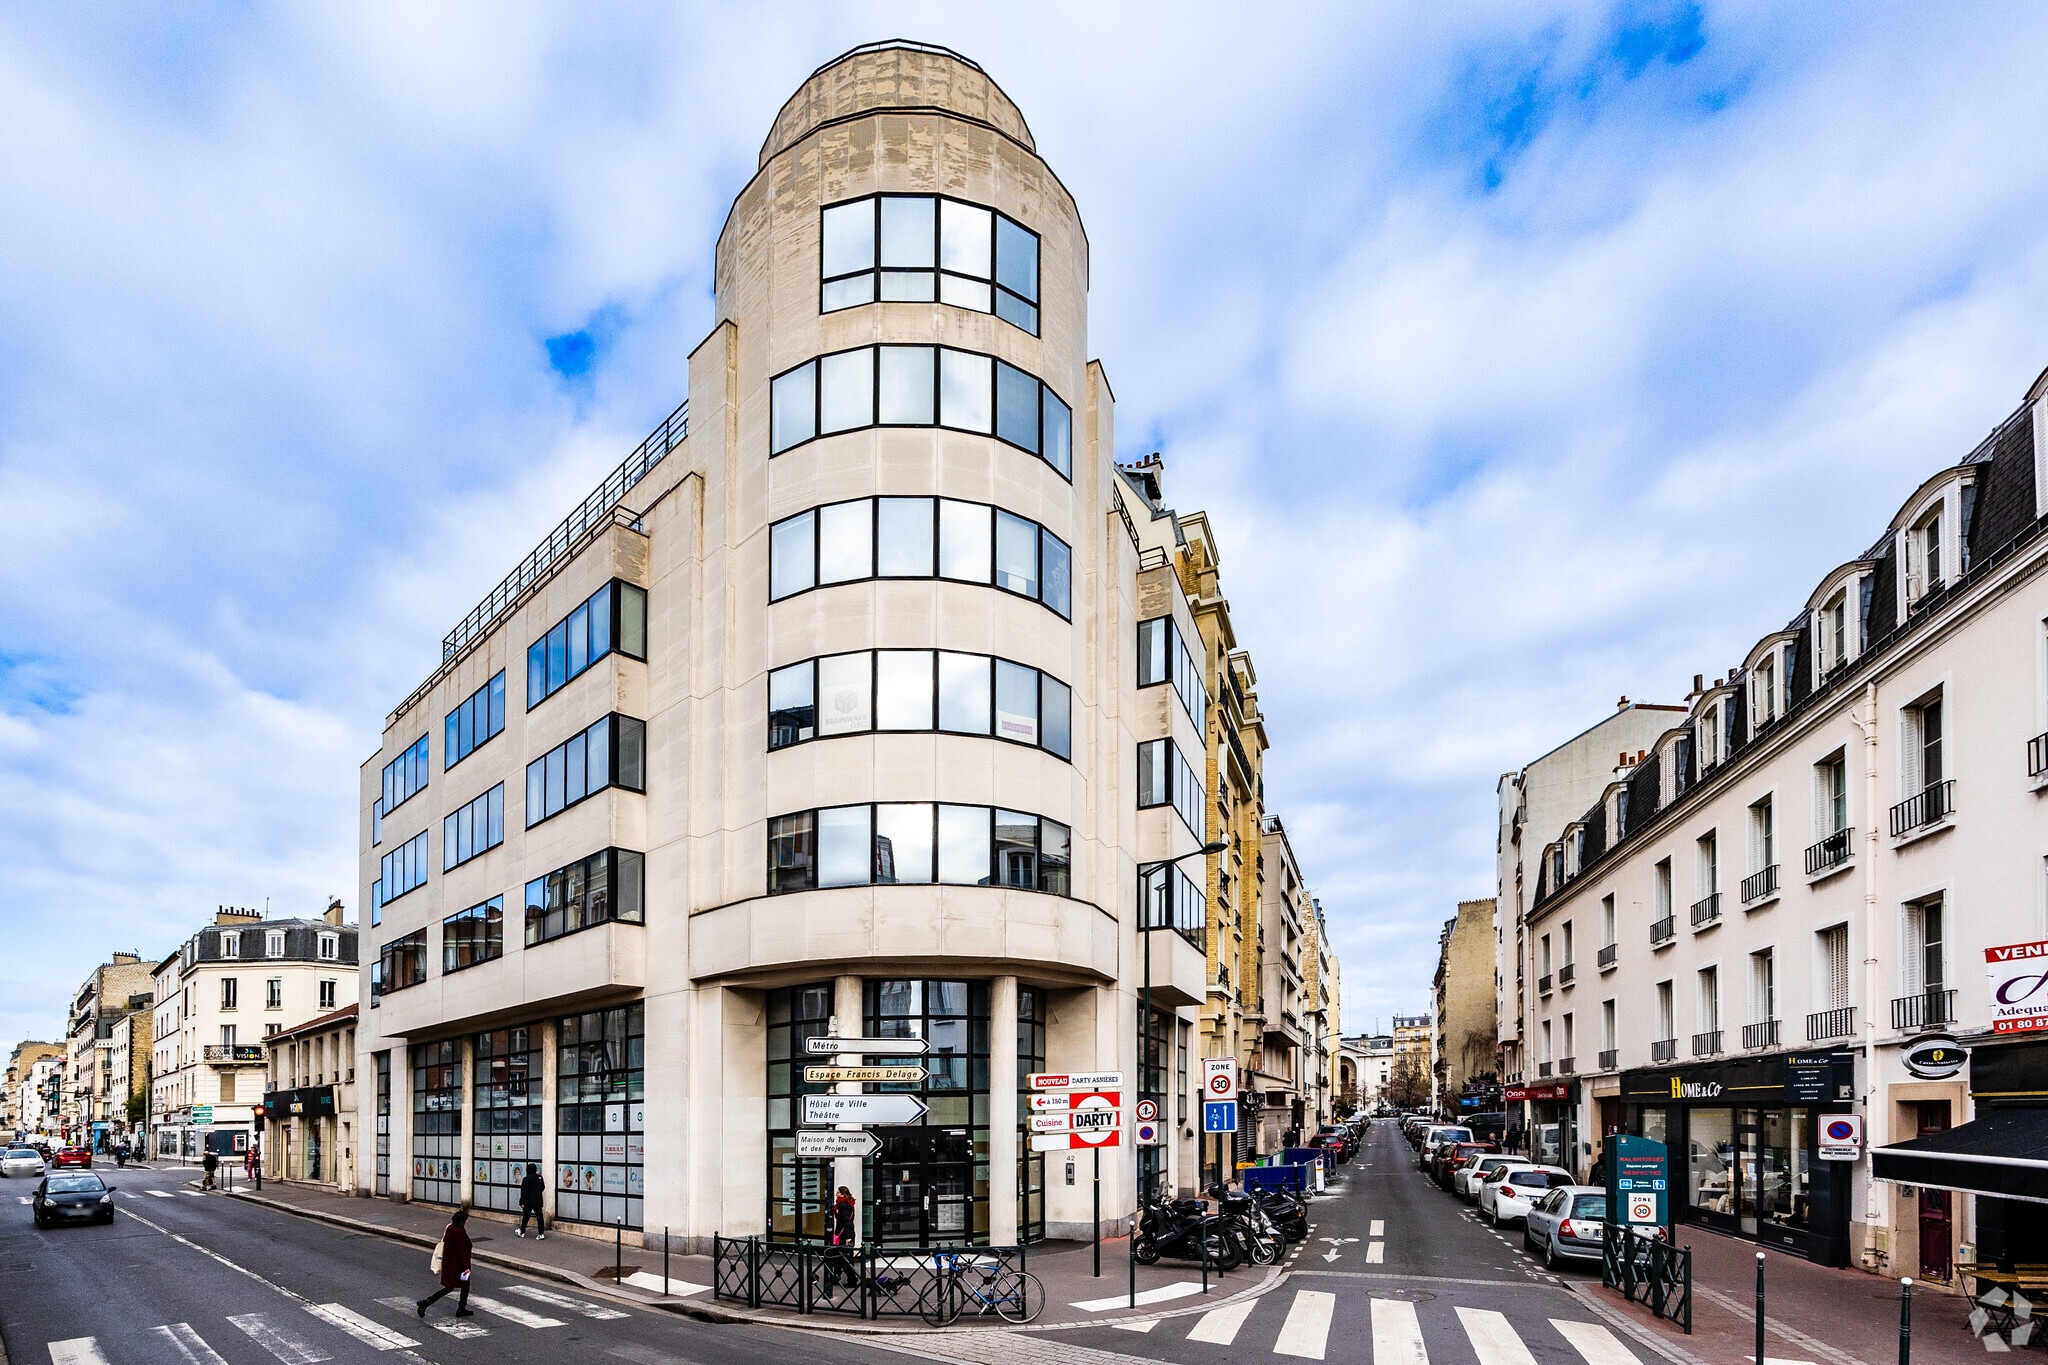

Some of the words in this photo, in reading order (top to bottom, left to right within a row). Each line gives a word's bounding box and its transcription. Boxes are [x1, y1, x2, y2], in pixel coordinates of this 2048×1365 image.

[825, 714, 867, 725] BRAINWAVE
[1998, 1021, 2013, 1031] 01
[2017, 1019, 2033, 1029] 80
[812, 1041, 839, 1050] Métro
[1210, 1063, 1230, 1071] ZONE
[809, 1070, 841, 1080] Espace
[846, 1070, 881, 1078] Francis
[885, 1070, 918, 1080] Delage
[1038, 1077, 1068, 1087] NOUVEAU
[1214, 1079, 1228, 1089] 30
[809, 1099, 831, 1108] Hôtel
[835, 1100, 845, 1108] de
[848, 1099, 867, 1108] Ville
[809, 1111, 840, 1119] Théâtre
[1075, 1112, 1114, 1128] DARTY
[1035, 1118, 1063, 1128] Cuisine
[824, 1145, 848, 1153] Projets
